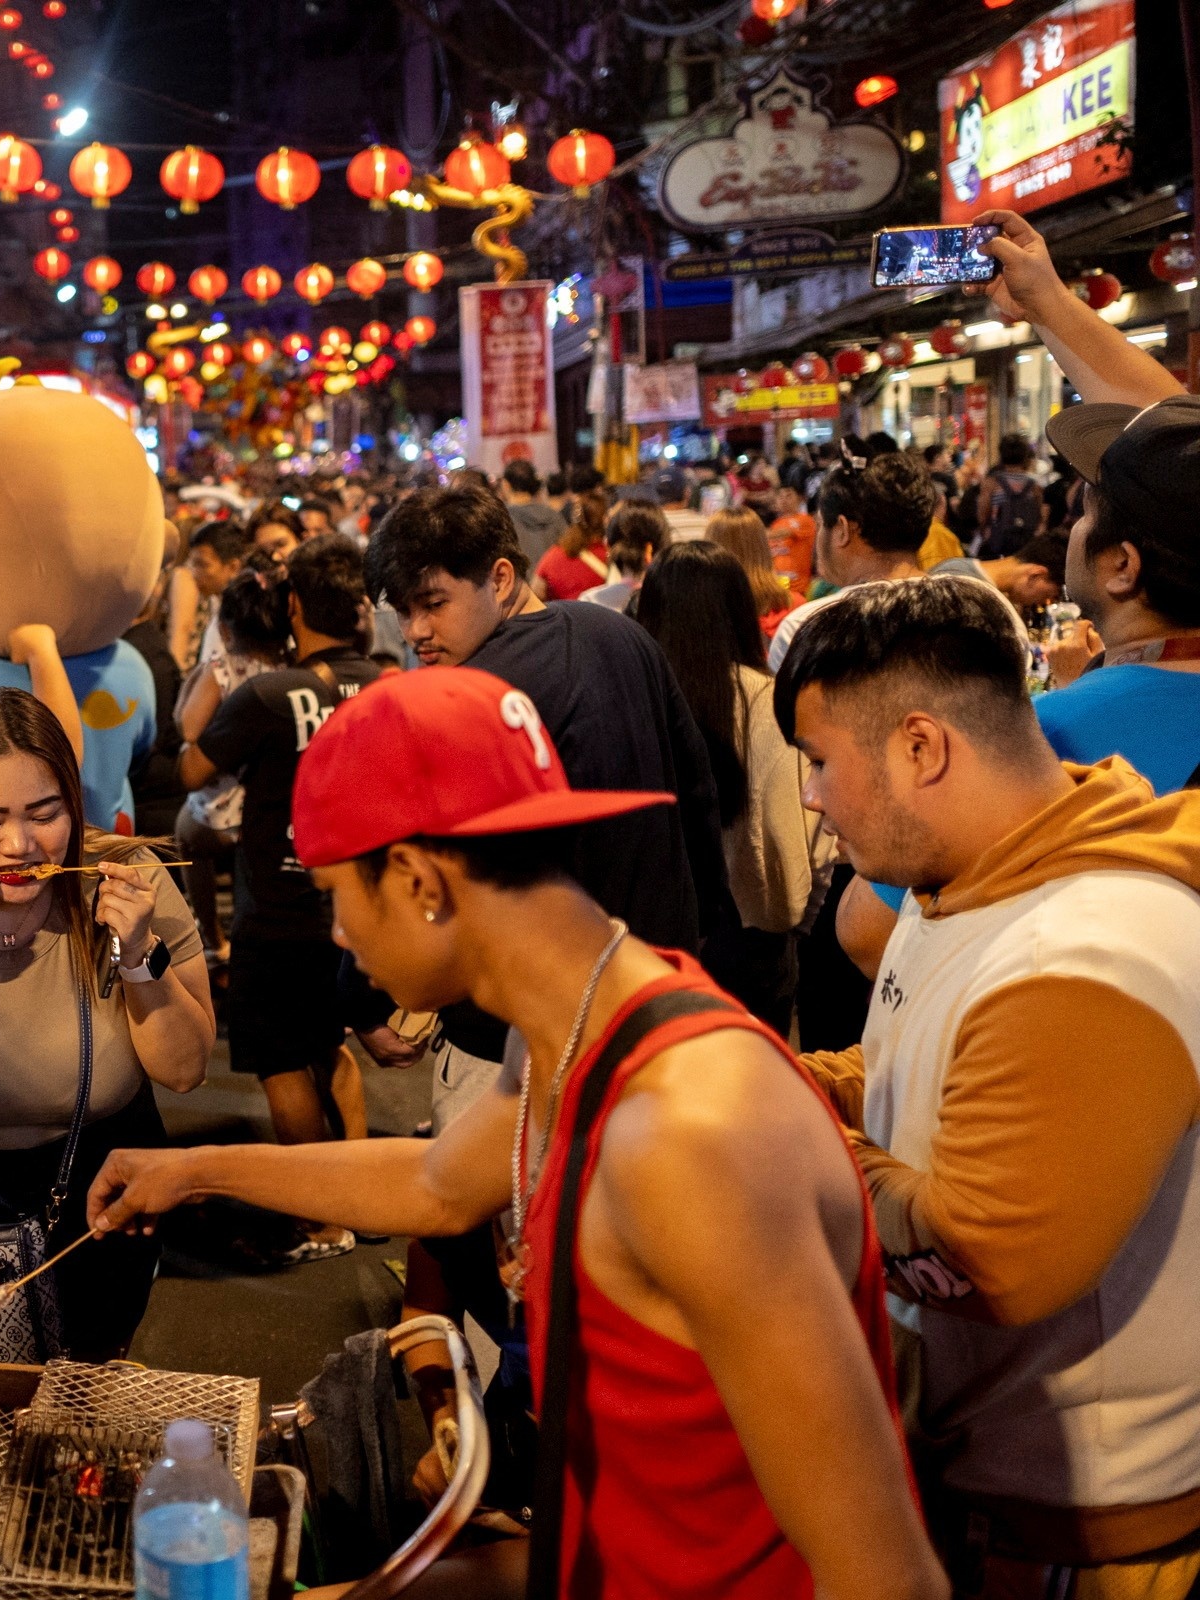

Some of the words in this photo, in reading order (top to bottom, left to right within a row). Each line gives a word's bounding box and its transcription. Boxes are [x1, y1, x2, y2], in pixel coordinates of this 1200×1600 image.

[1063, 65, 1113, 125] KEE
[338, 683, 360, 699] THE
[500, 689, 551, 770] P
